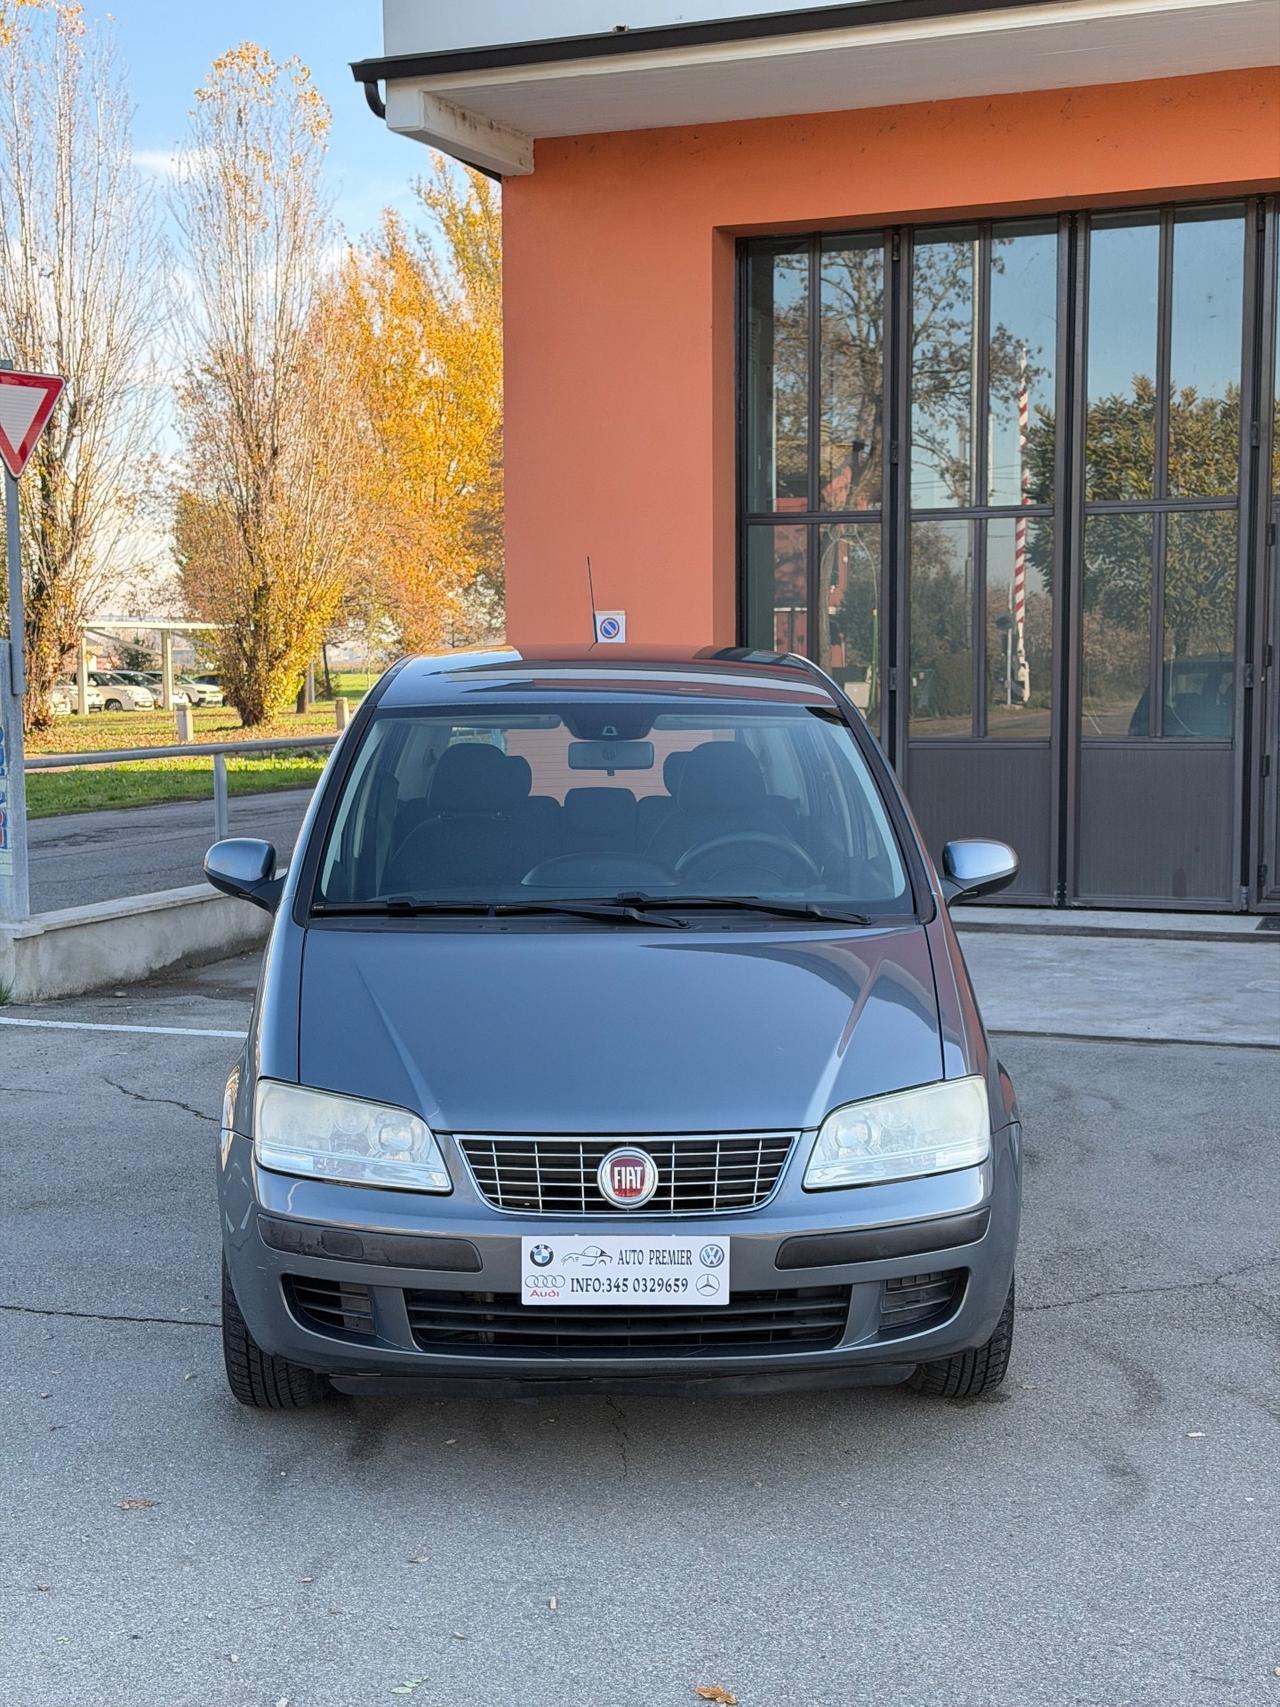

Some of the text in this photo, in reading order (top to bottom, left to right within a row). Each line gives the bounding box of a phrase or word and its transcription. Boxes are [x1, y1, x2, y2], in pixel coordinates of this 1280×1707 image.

[613, 1166, 643, 1189] FIAT
[617, 1249, 693, 1265] AUTO PREMIER
[570, 1277, 689, 1293] INFO:345 0329659
[529, 1289, 560, 1298] Audi
